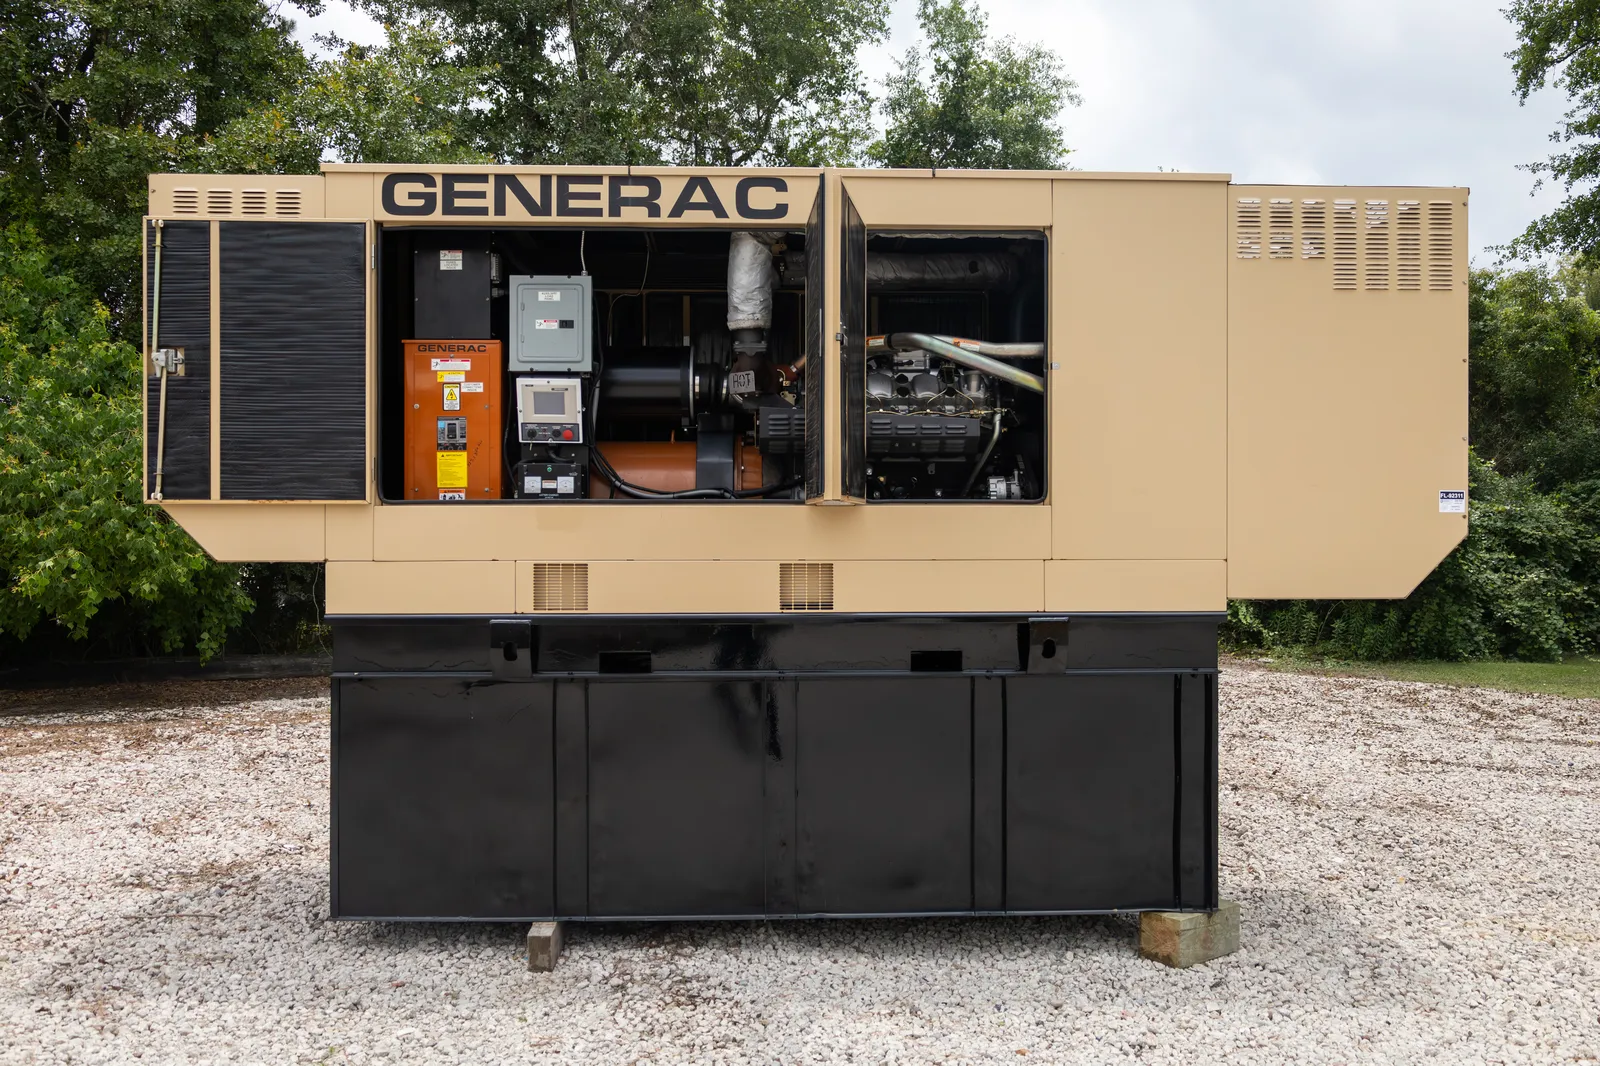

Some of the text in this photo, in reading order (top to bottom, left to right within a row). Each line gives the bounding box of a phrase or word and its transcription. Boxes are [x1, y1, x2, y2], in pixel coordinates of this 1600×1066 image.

[381, 173, 789, 219] GENERAC
[417, 344, 487, 352] GENERAC
[732, 372, 751, 388] HOT
